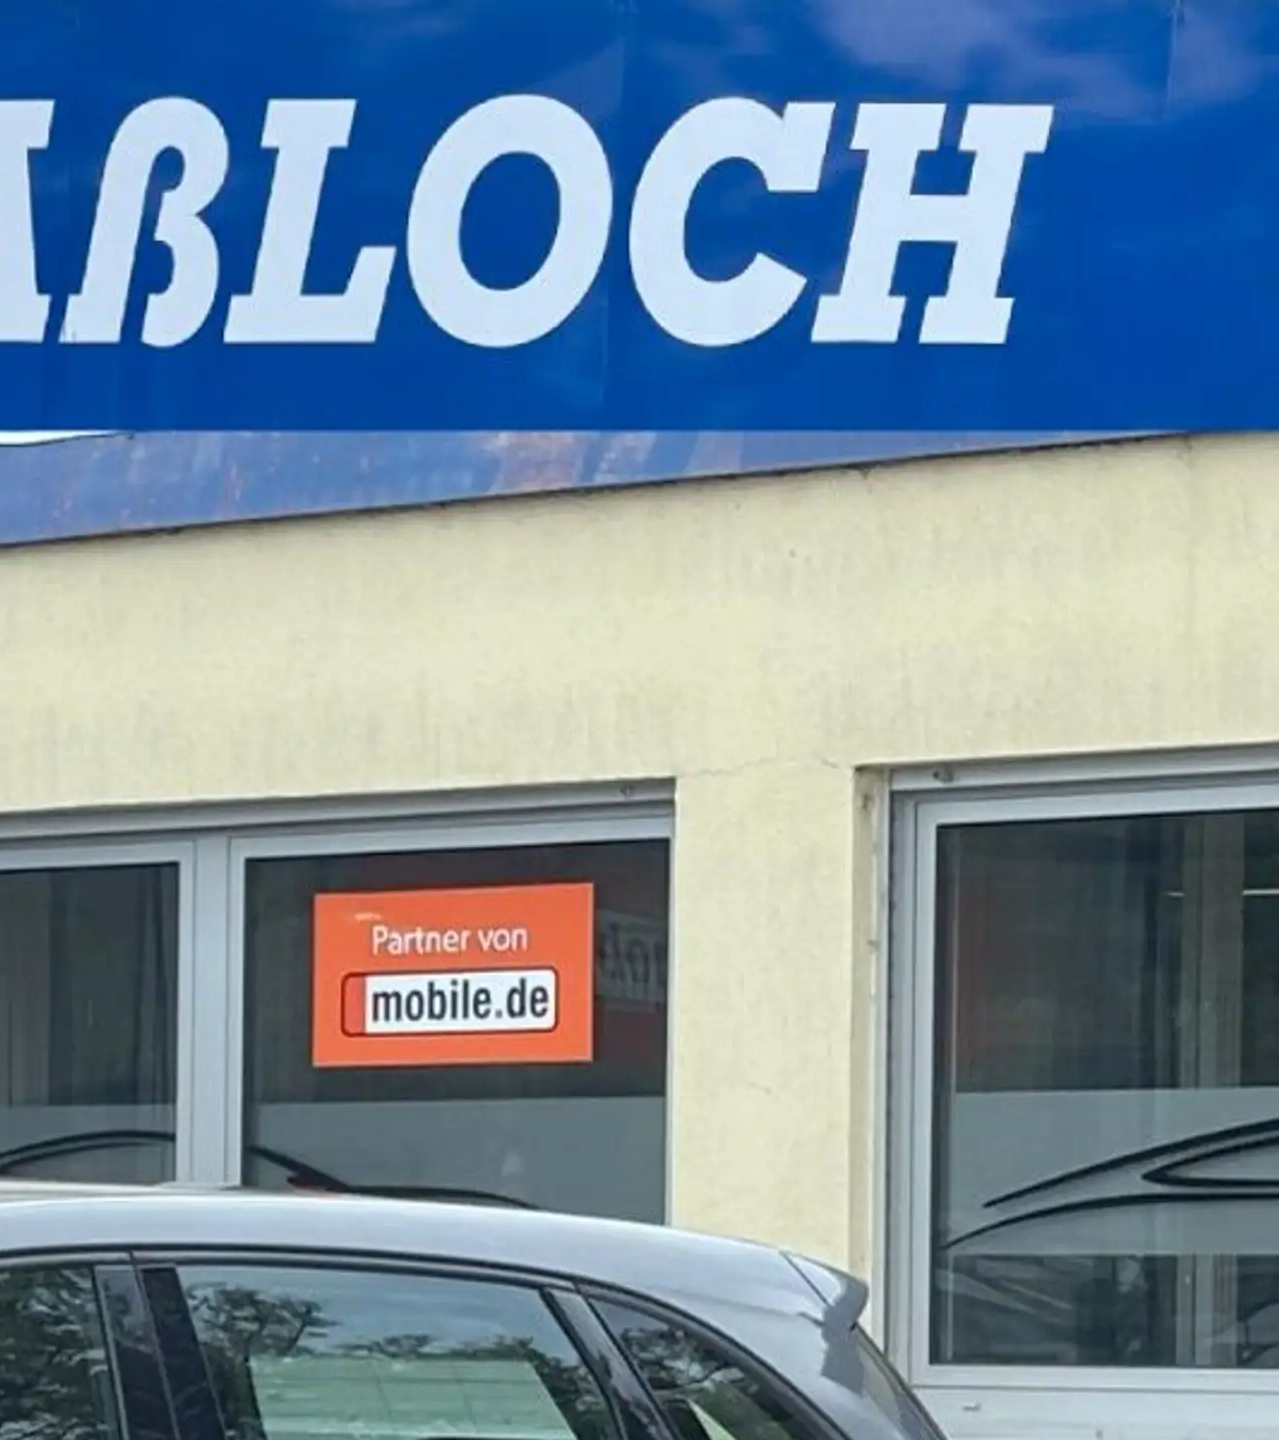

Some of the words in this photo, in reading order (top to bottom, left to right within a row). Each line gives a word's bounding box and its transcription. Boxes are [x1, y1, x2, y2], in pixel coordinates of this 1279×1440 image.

[371, 925, 470, 954] Partner
[477, 928, 528, 951] von
[372, 979, 549, 1022] mobile.de
